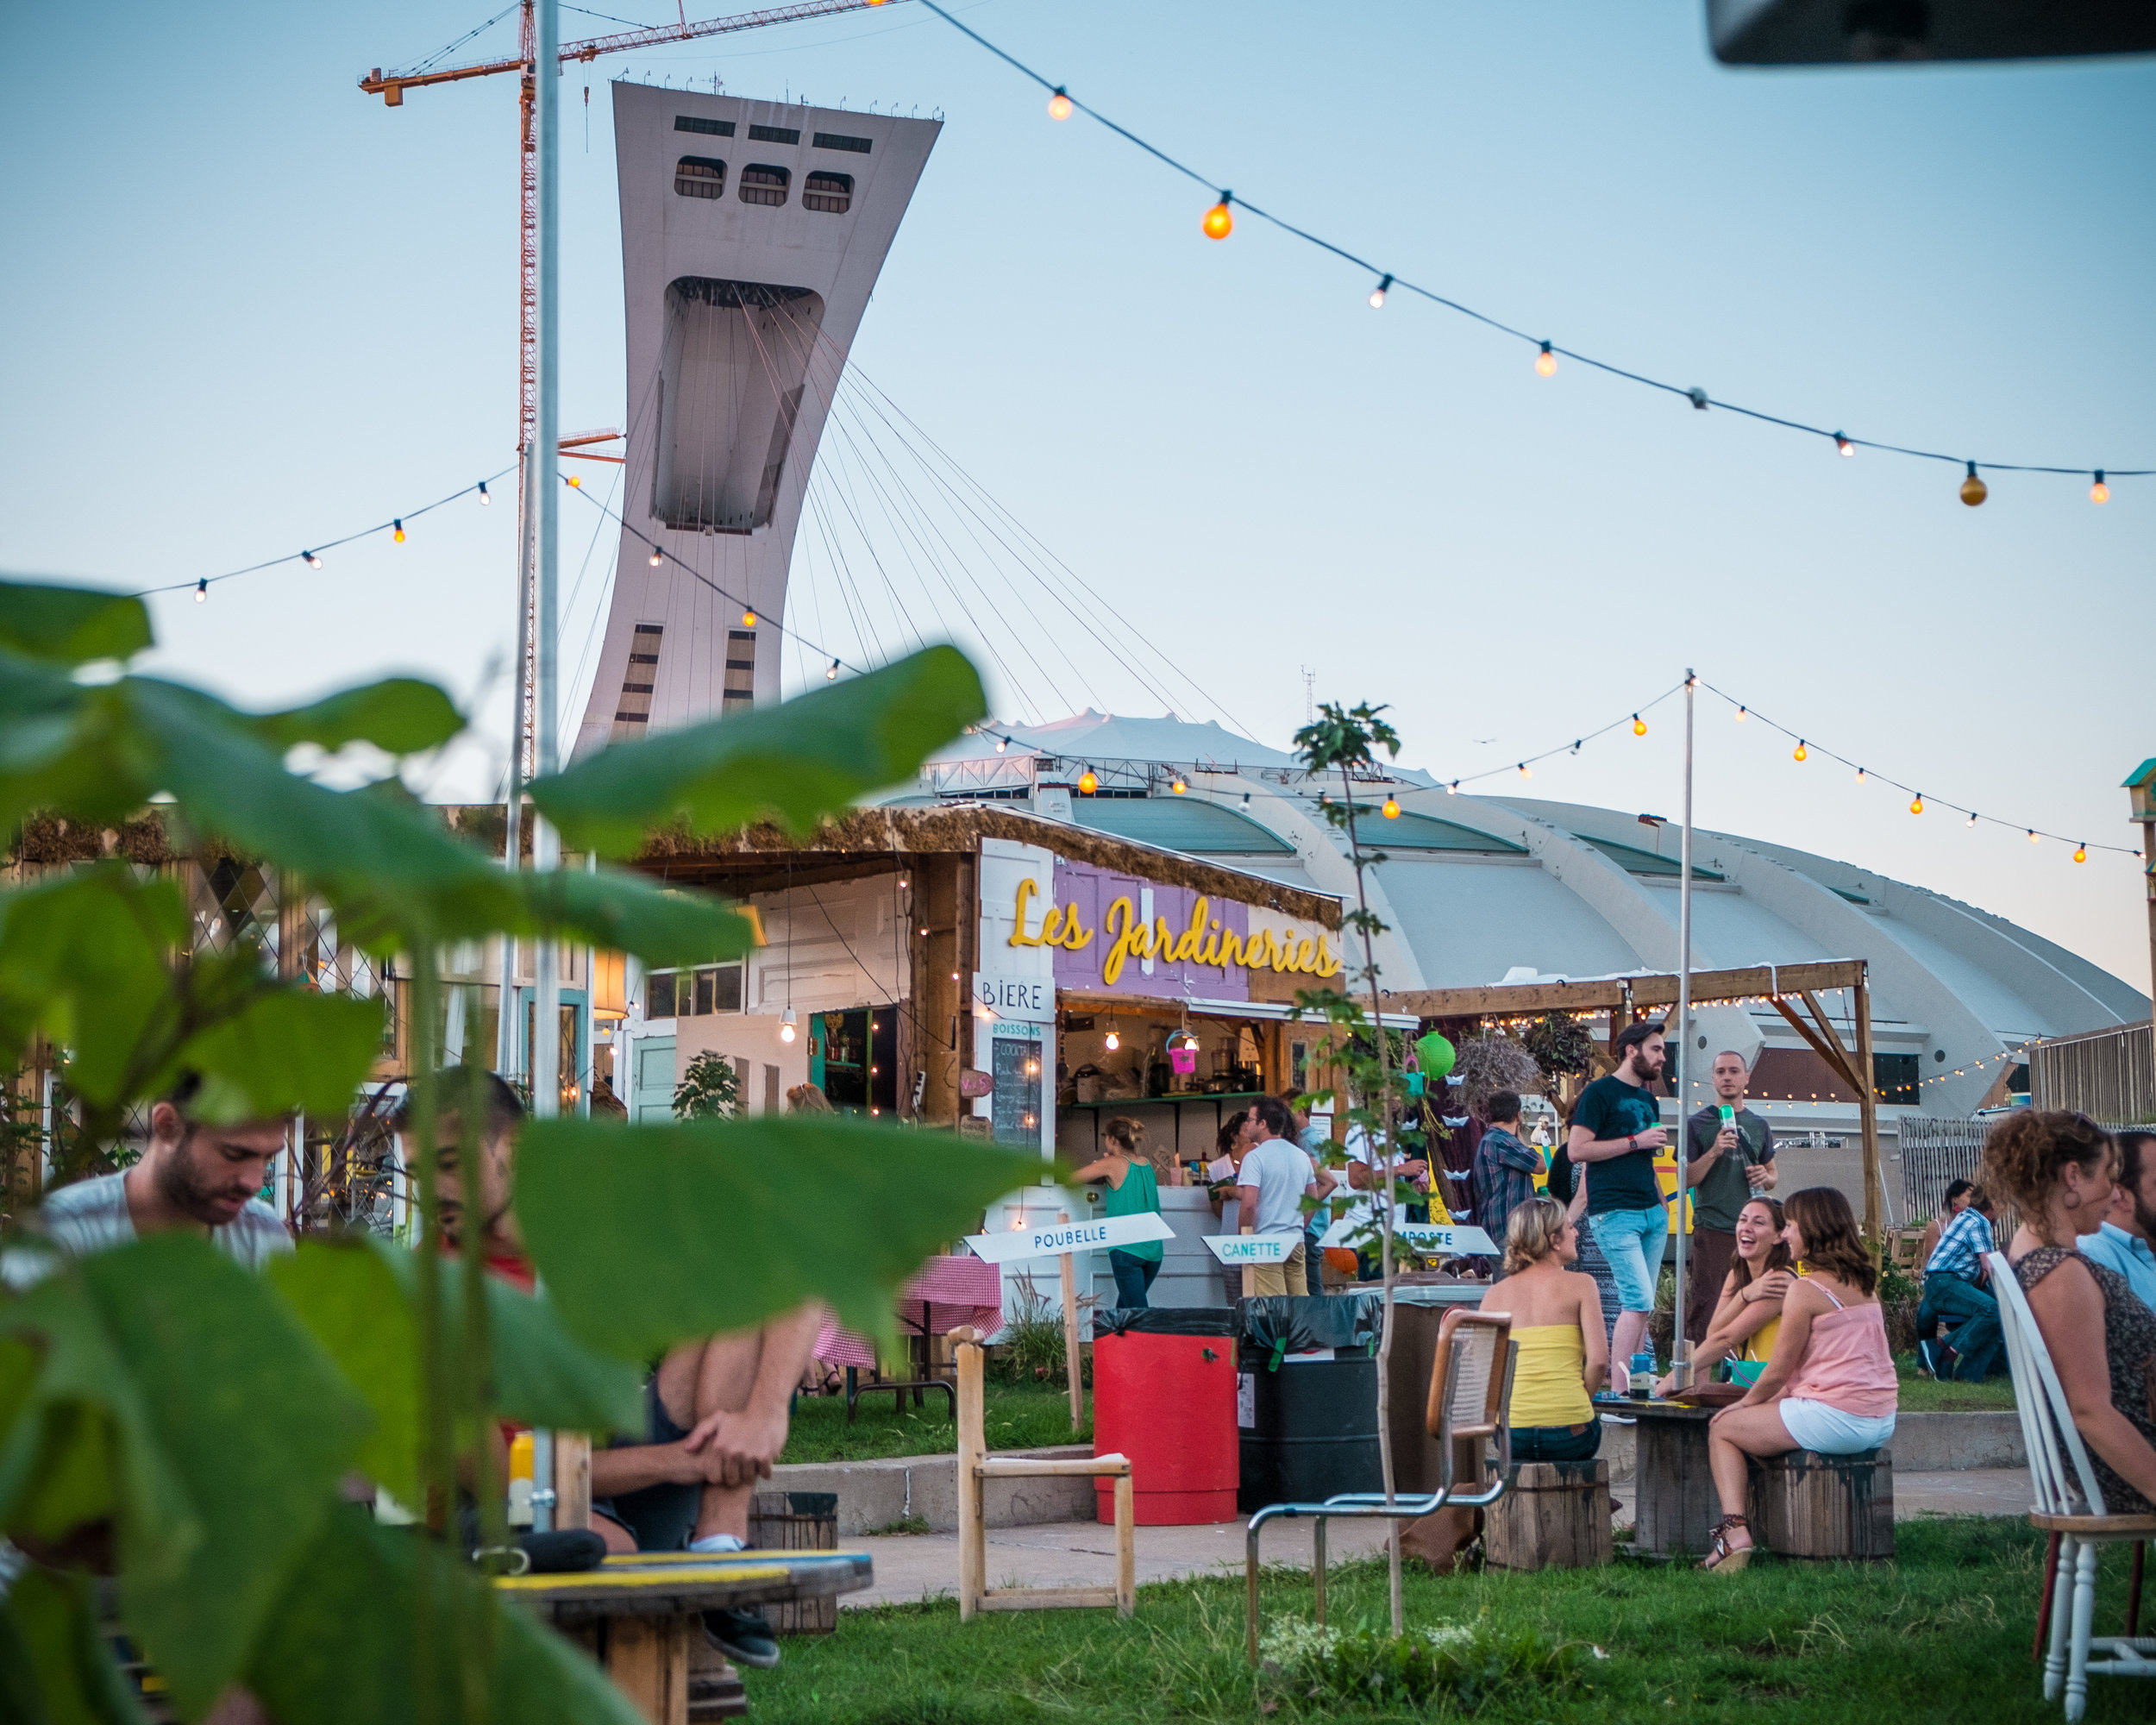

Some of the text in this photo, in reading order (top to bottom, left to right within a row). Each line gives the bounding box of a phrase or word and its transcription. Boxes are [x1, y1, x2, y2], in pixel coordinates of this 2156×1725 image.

[1009, 877, 1342, 986] Les Jardineries
[992, 1023, 1041, 1037] BOISSONS
[1034, 1226, 1107, 1249] POUBELLE
[1222, 1243, 1281, 1257] CANETTE
